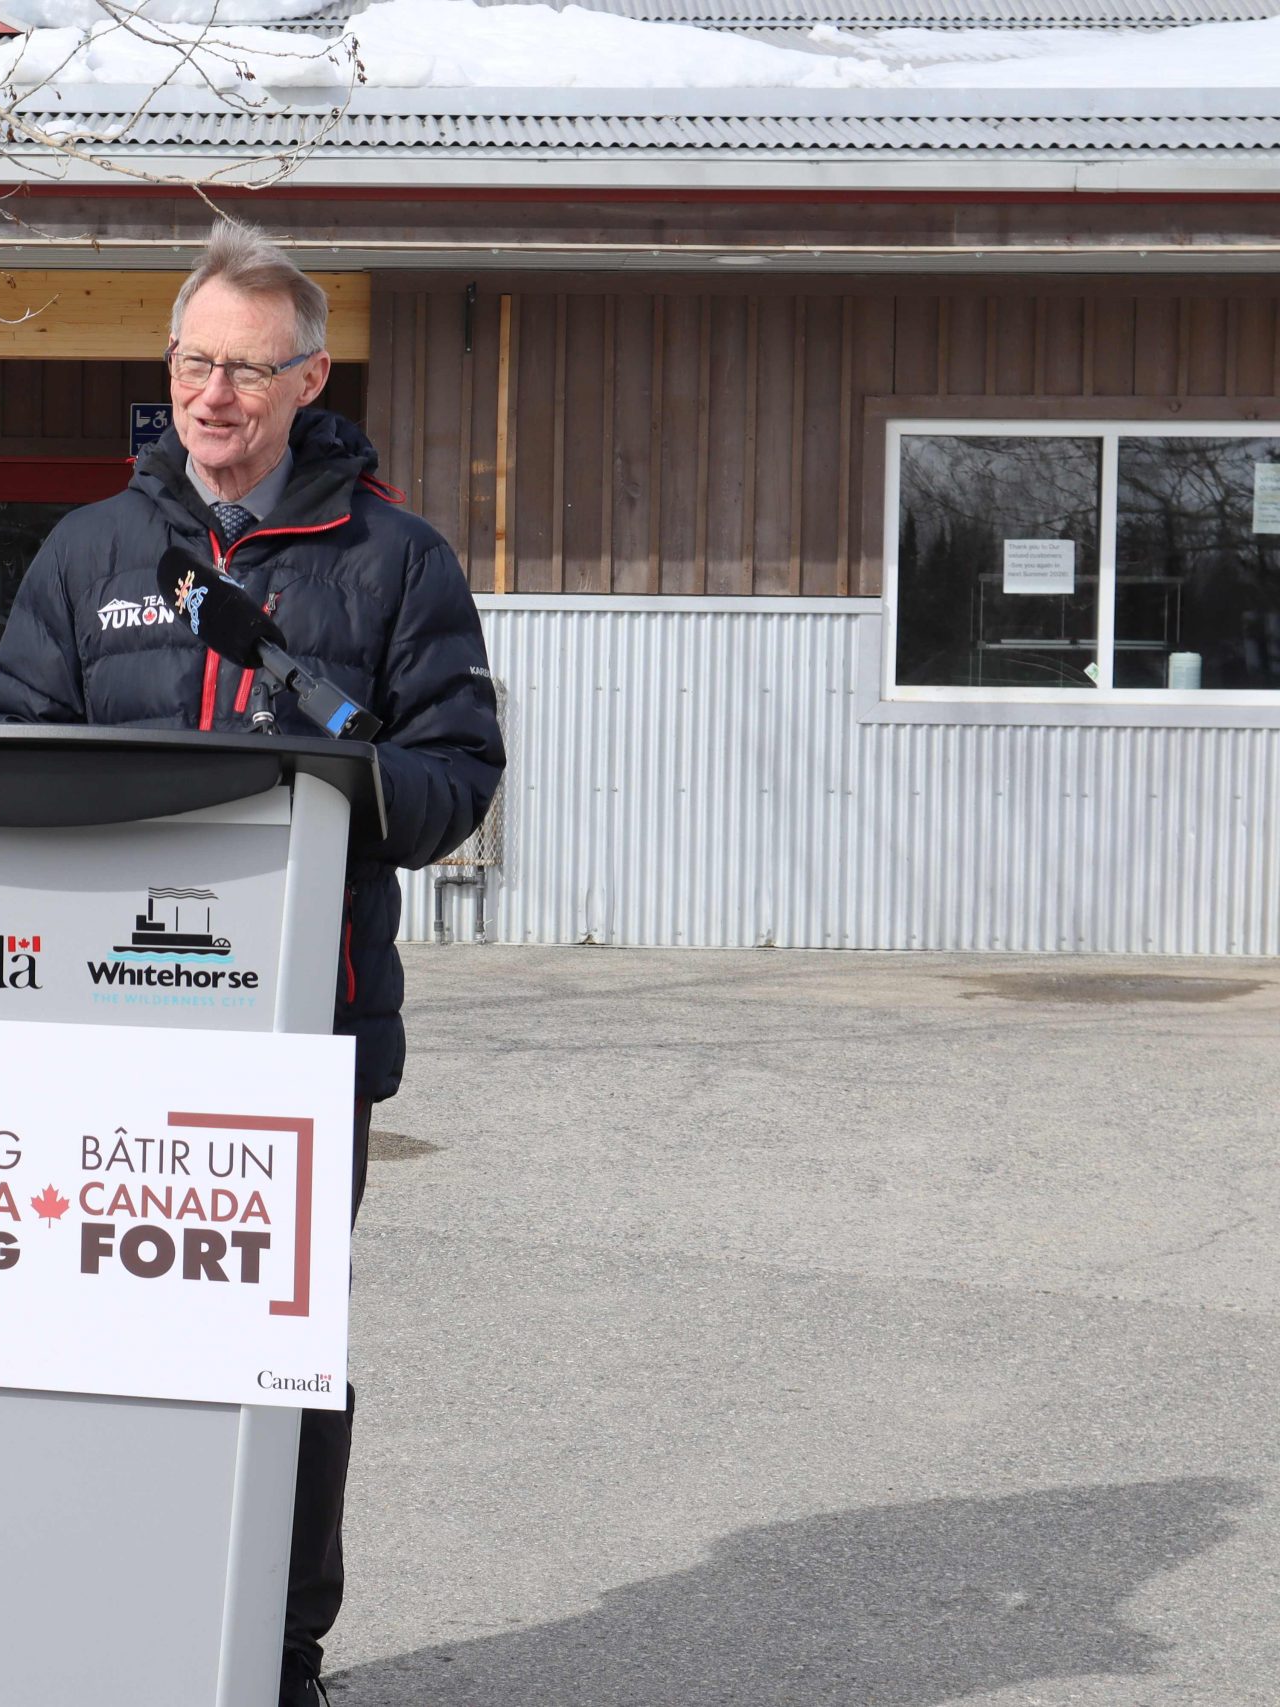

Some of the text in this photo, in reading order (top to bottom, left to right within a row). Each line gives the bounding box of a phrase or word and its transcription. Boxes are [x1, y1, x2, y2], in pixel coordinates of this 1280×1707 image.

[143, 595, 167, 607] TEA
[97, 606, 175, 631] YUKON
[87, 961, 259, 989] Whitehorse
[91, 992, 257, 1008] THE WILDERNESS CITY
[81, 1126, 273, 1181] BÂTIR UN
[79, 1181, 271, 1225] CANADA
[80, 1222, 271, 1284] FORT
[257, 1370, 332, 1393] Canada
